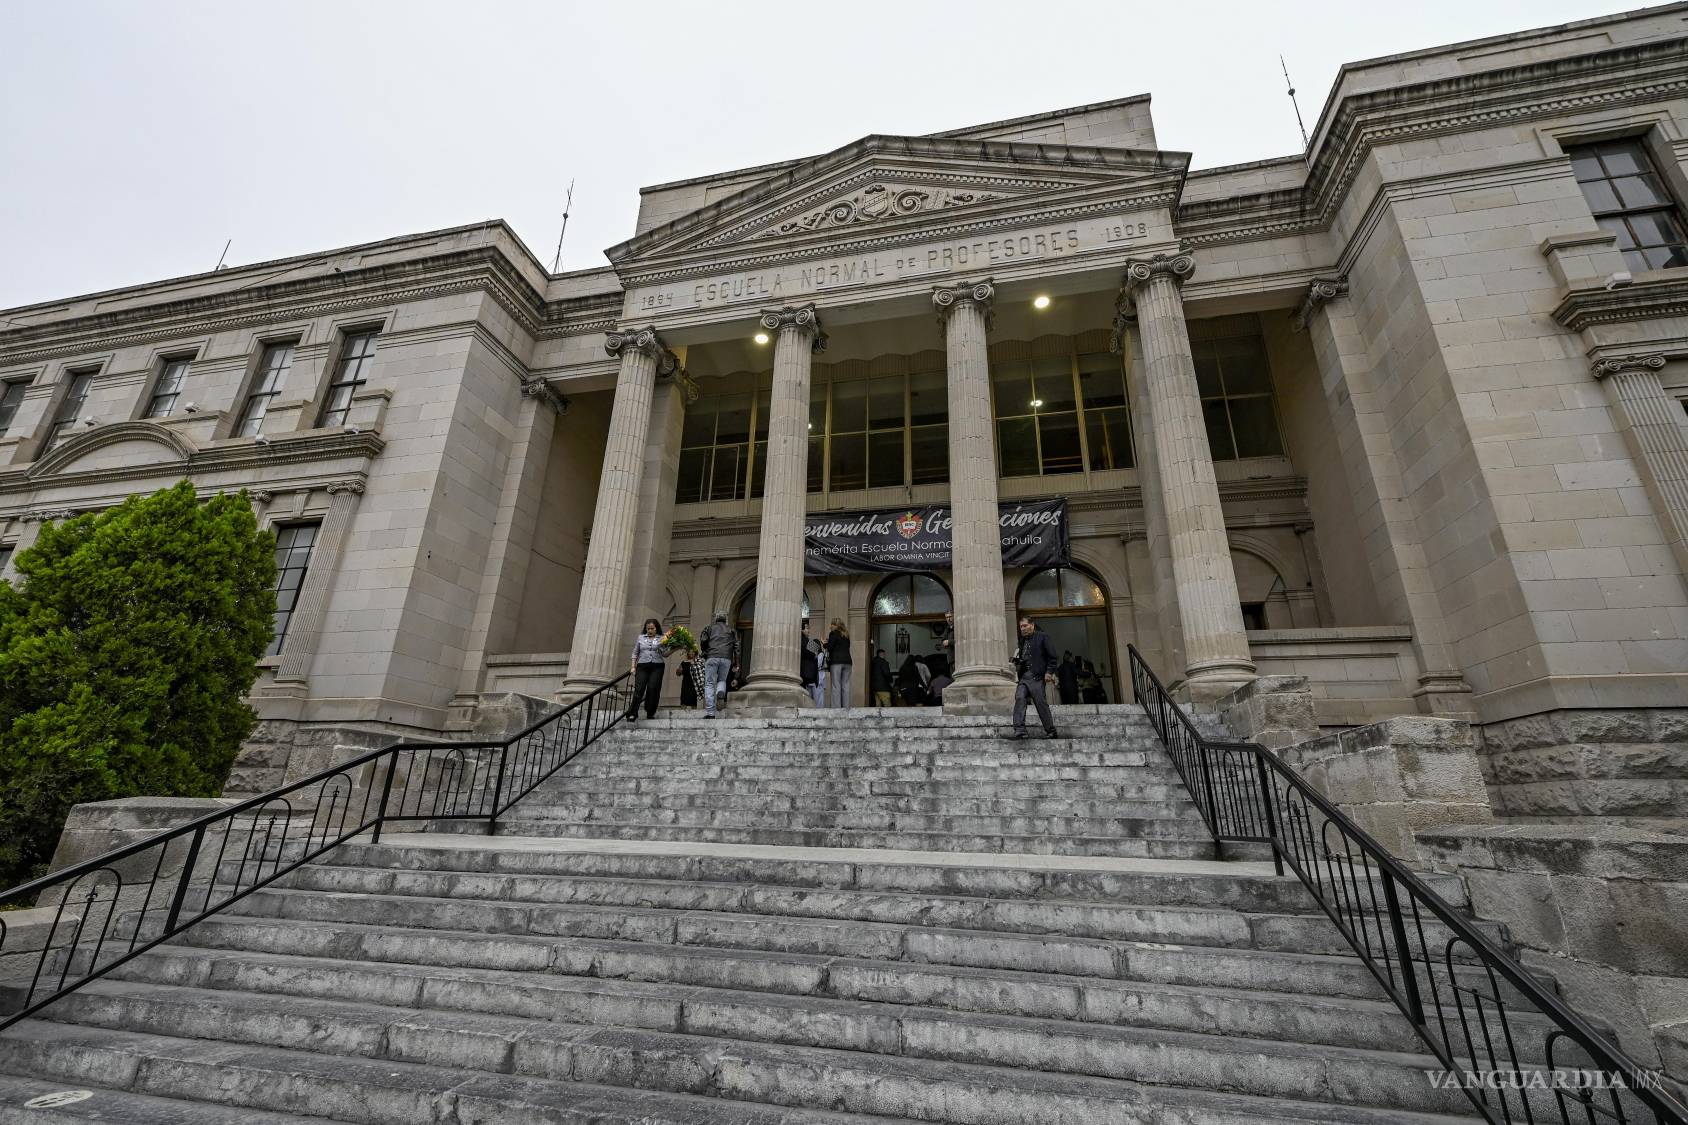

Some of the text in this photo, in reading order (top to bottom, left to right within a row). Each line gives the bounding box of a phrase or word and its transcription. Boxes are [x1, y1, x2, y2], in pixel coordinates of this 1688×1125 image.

[642, 222, 1147, 307] 1894 ESCUELA NORMAL DE PROFESORES 1908
[804, 514, 893, 538] envenidas
[805, 534, 1042, 557] nemérita Escuela Norma ahuila
[870, 554, 895, 562] LABOR
[925, 551, 950, 559] VINCIT
